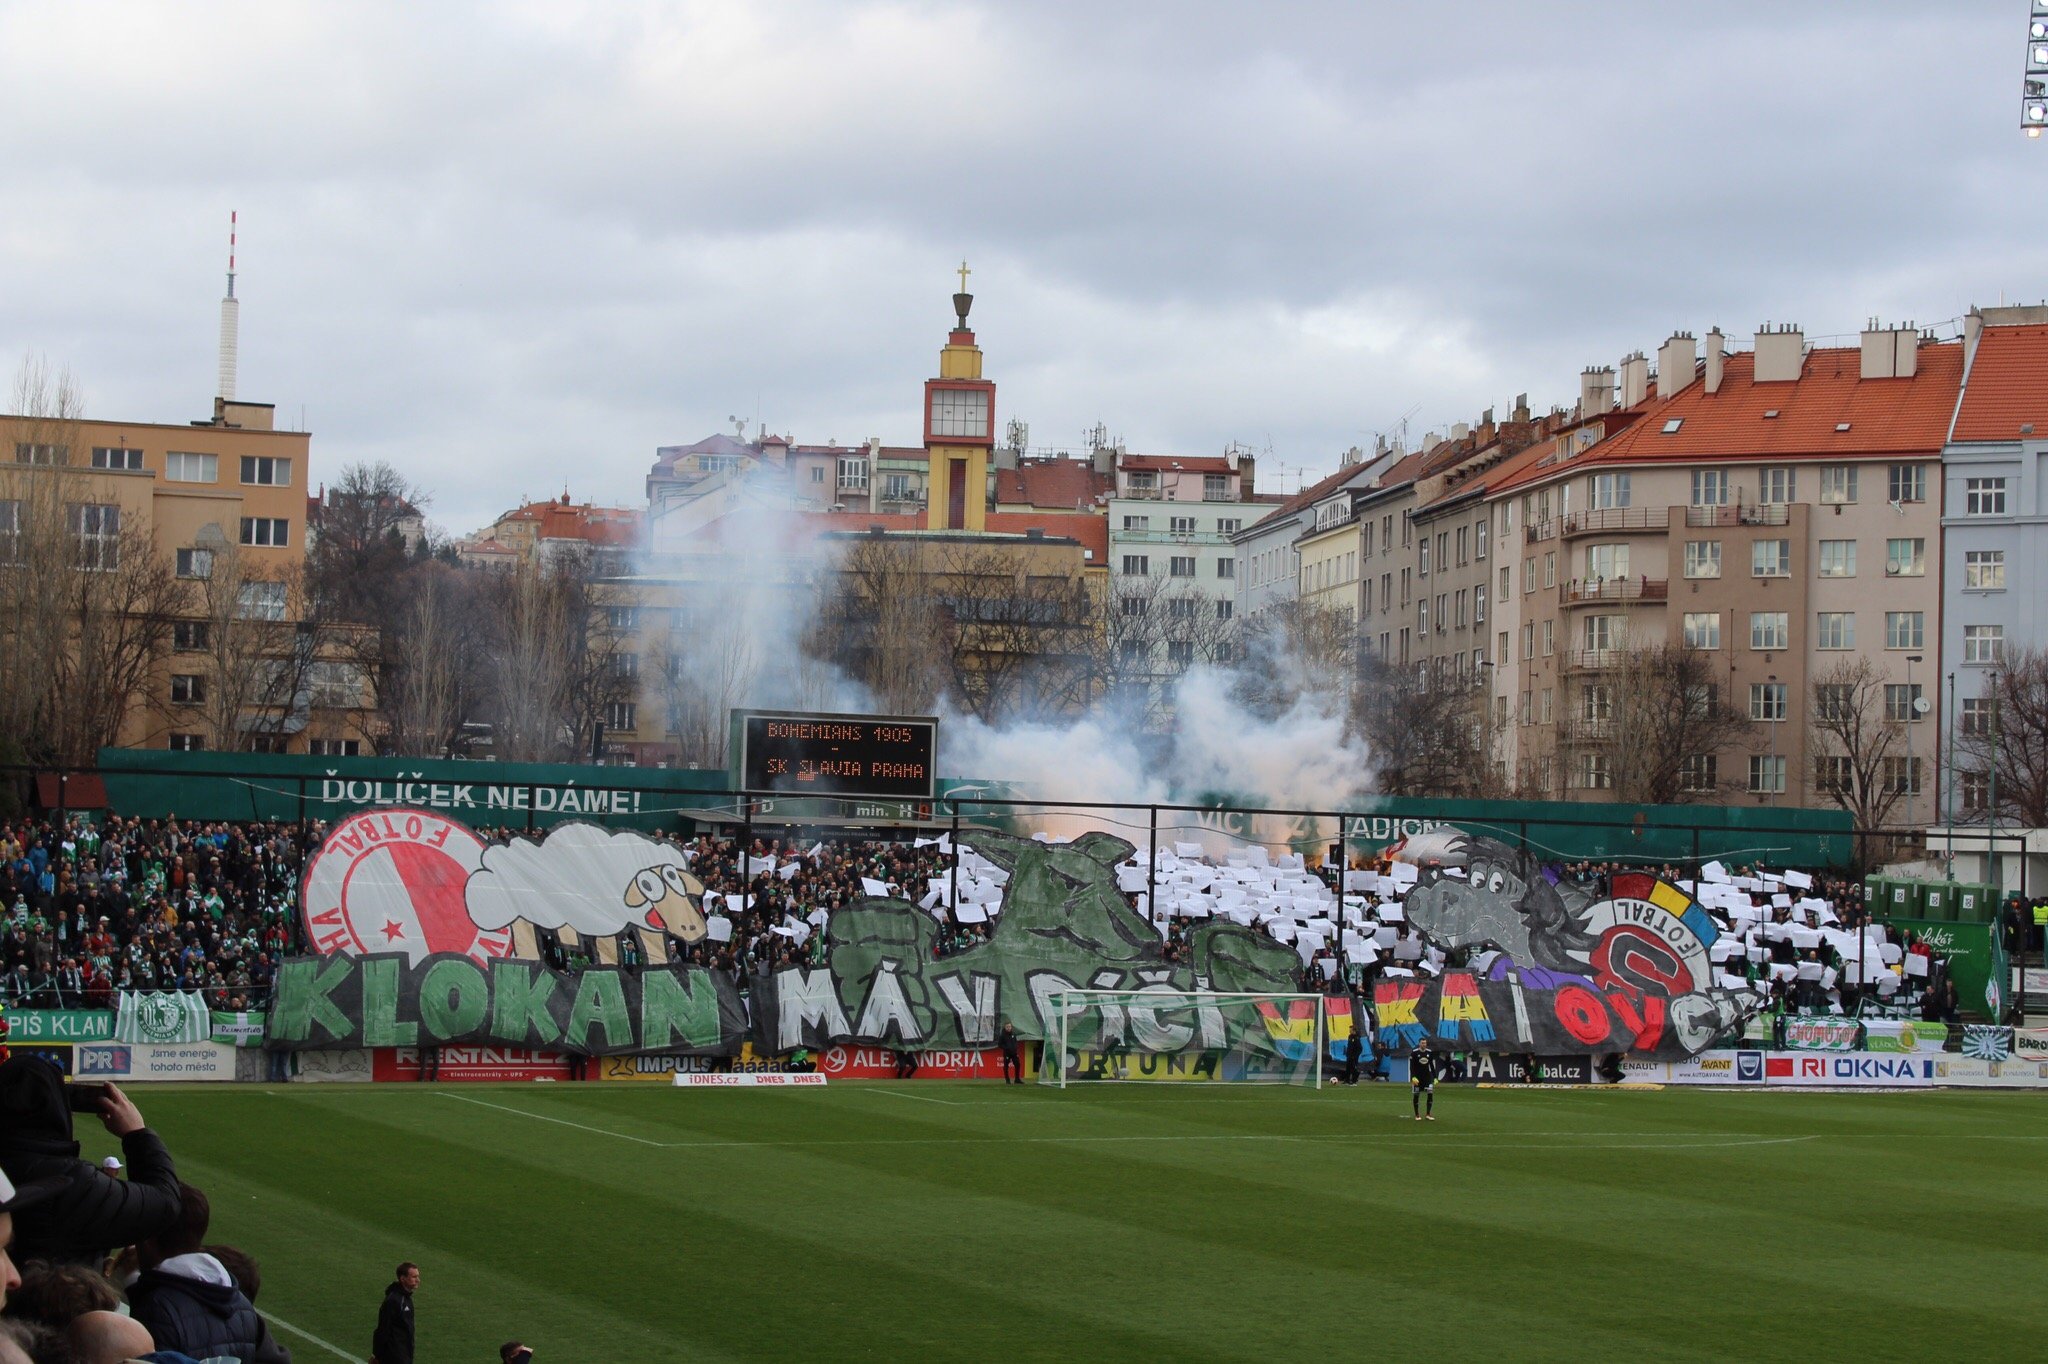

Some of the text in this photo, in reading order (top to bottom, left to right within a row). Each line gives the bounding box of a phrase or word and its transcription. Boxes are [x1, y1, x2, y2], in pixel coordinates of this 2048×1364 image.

[768, 722, 912, 742] BOHEMIANS 1905
[767, 758, 923, 778] SK SLAVIA PRAHA
[322, 769, 641, 813] ĎOLÍČEK NEDÁME!
[856, 804, 889, 817] min.
[327, 814, 452, 858] FOTBAL
[1617, 901, 1697, 955] FOTBAL
[1917, 926, 1955, 947] Lukáš
[271, 955, 721, 1050] KLOKAN
[778, 962, 922, 1051] MÁ
[1257, 973, 1497, 1062] VLKA
[52, 1015, 108, 1036] KLAN
[83, 1052, 126, 1069] PRE
[150, 1049, 218, 1060] Jsme energie
[1701, 1060, 1731, 1069] AVANT
[150, 1062, 183, 1072] tohoto
[1802, 1058, 1915, 1078] RI OKNA
[689, 1074, 739, 1085] iDNES.cz
[756, 1076, 821, 1084] DNES DNES
